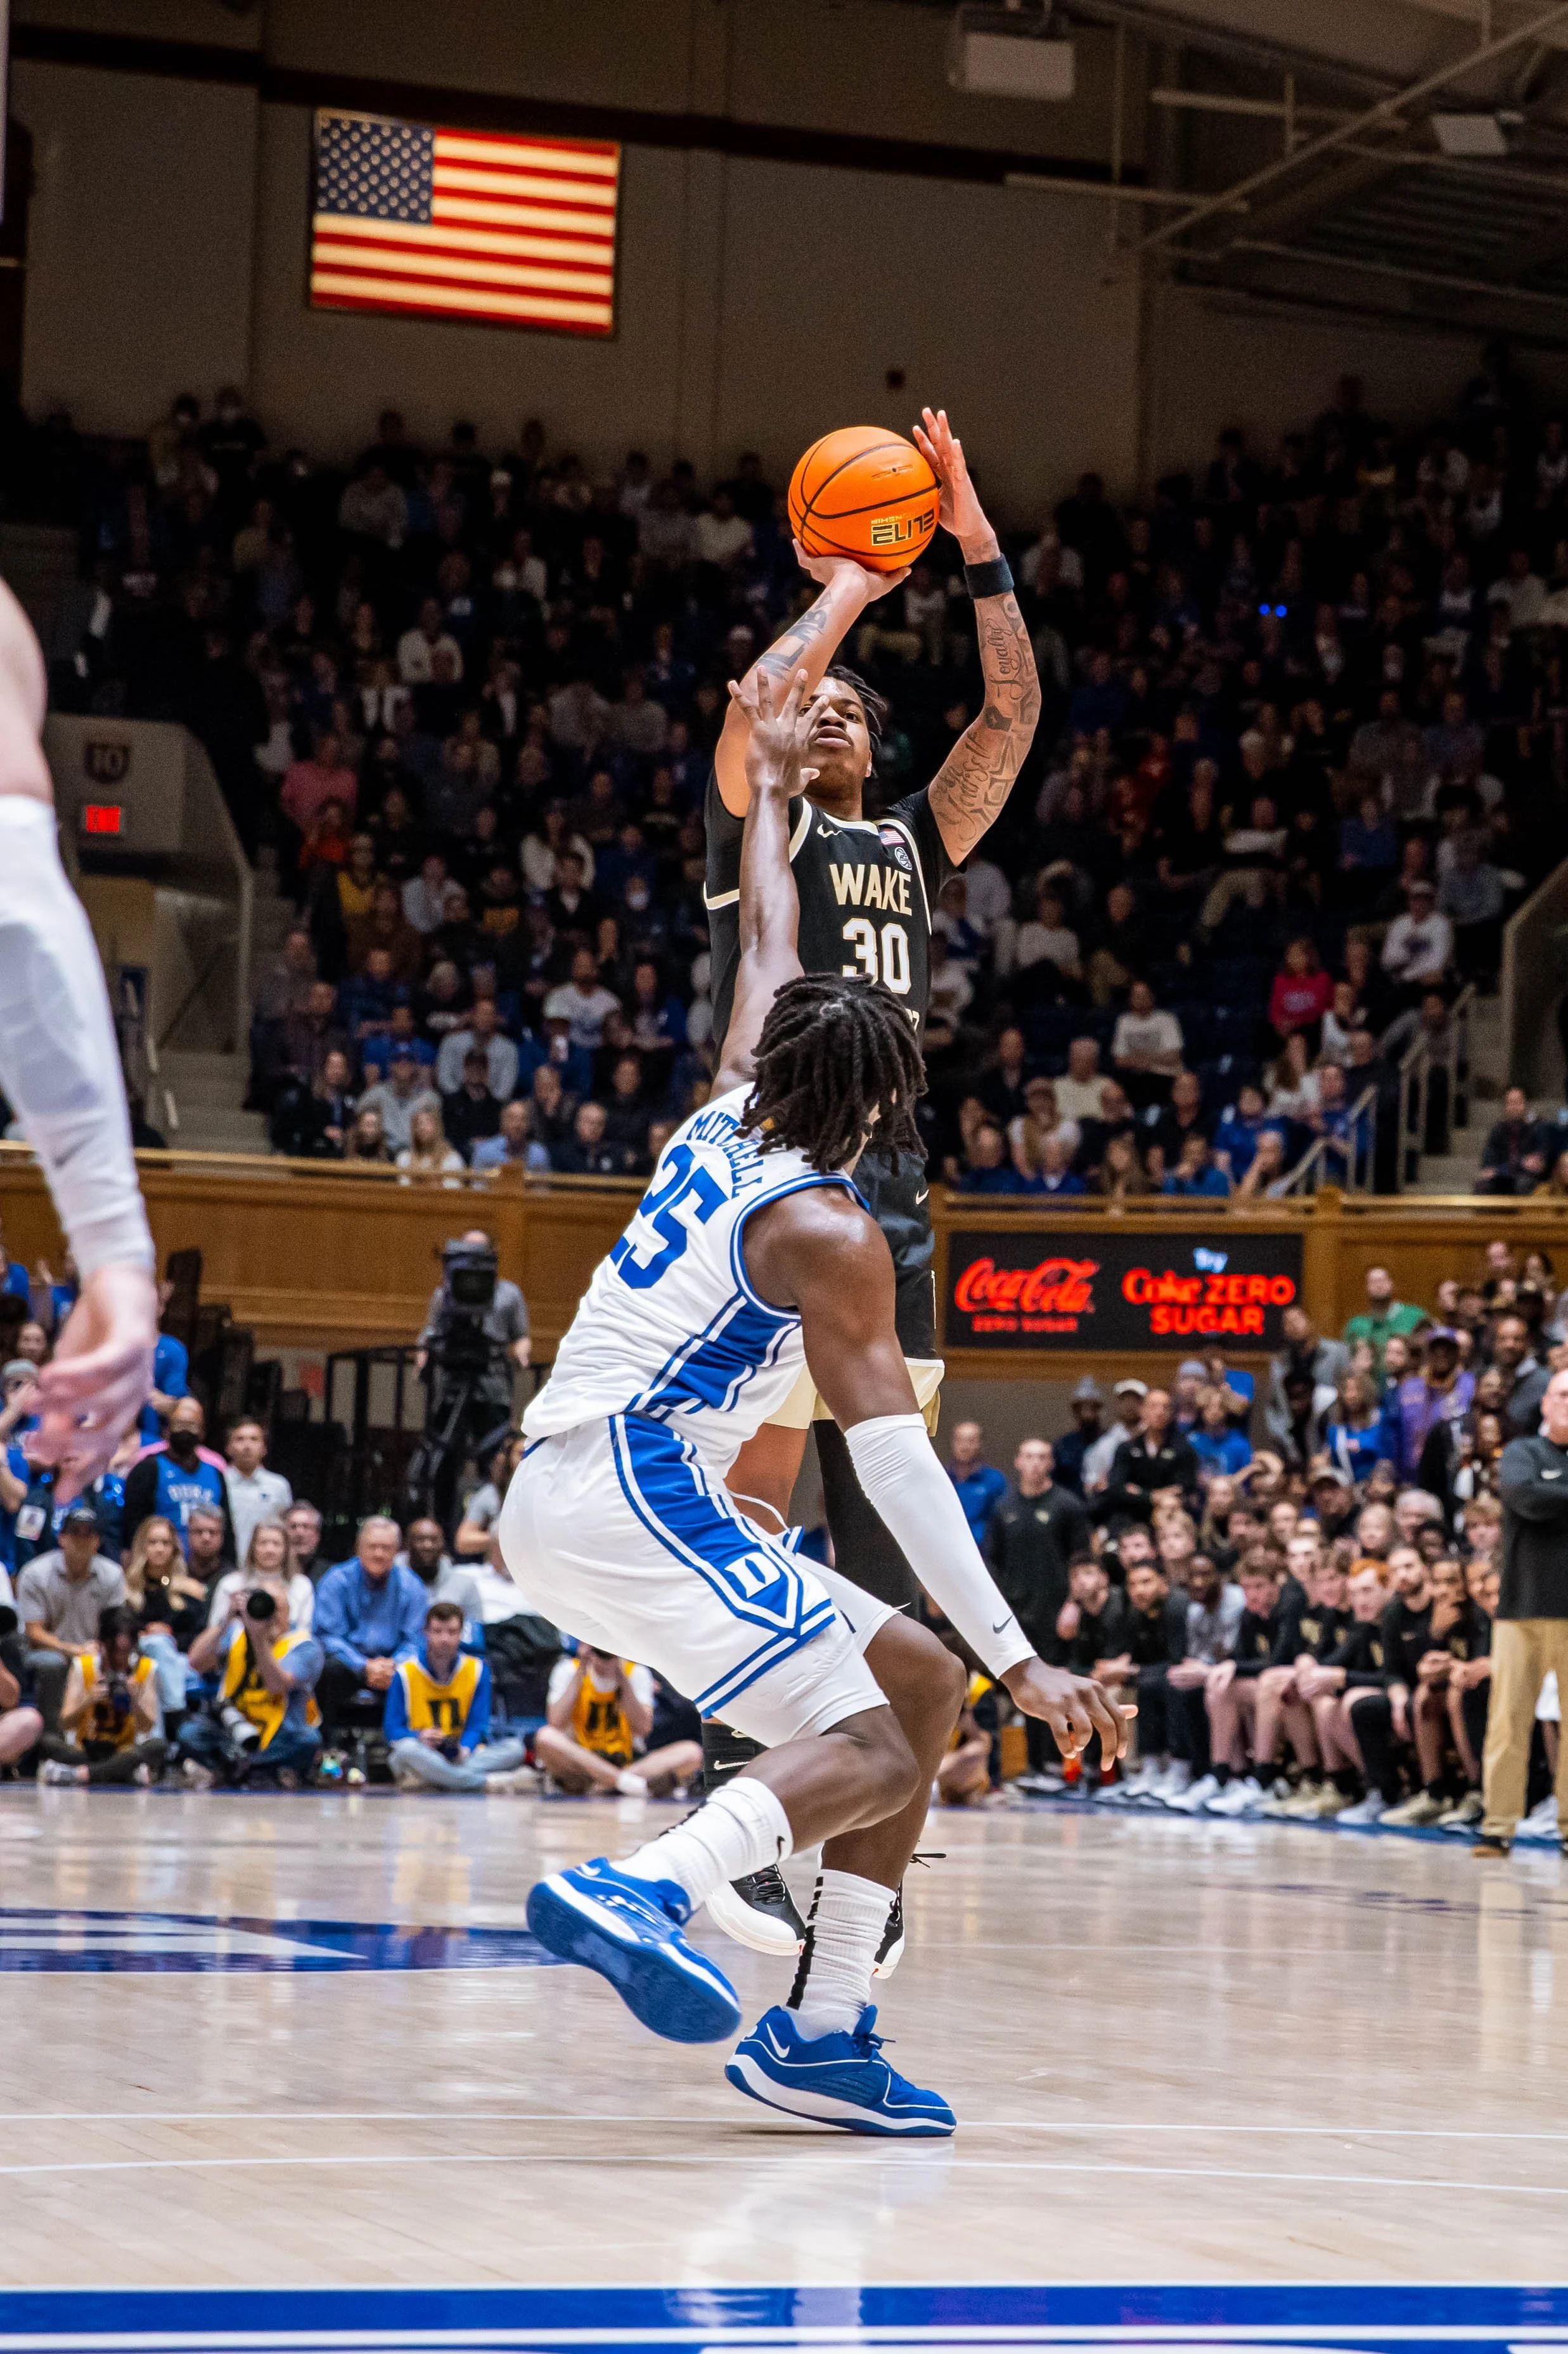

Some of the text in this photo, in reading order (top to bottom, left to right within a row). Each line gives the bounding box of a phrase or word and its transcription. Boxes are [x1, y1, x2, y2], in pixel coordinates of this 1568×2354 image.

[871, 508, 935, 546] ELITE
[829, 863, 912, 916] WAKE
[842, 918, 911, 994] 30
[610, 1143, 729, 1289] 25
[1123, 1267, 1295, 1305] Coke ZERO
[1150, 1303, 1264, 1334] SUGAR
